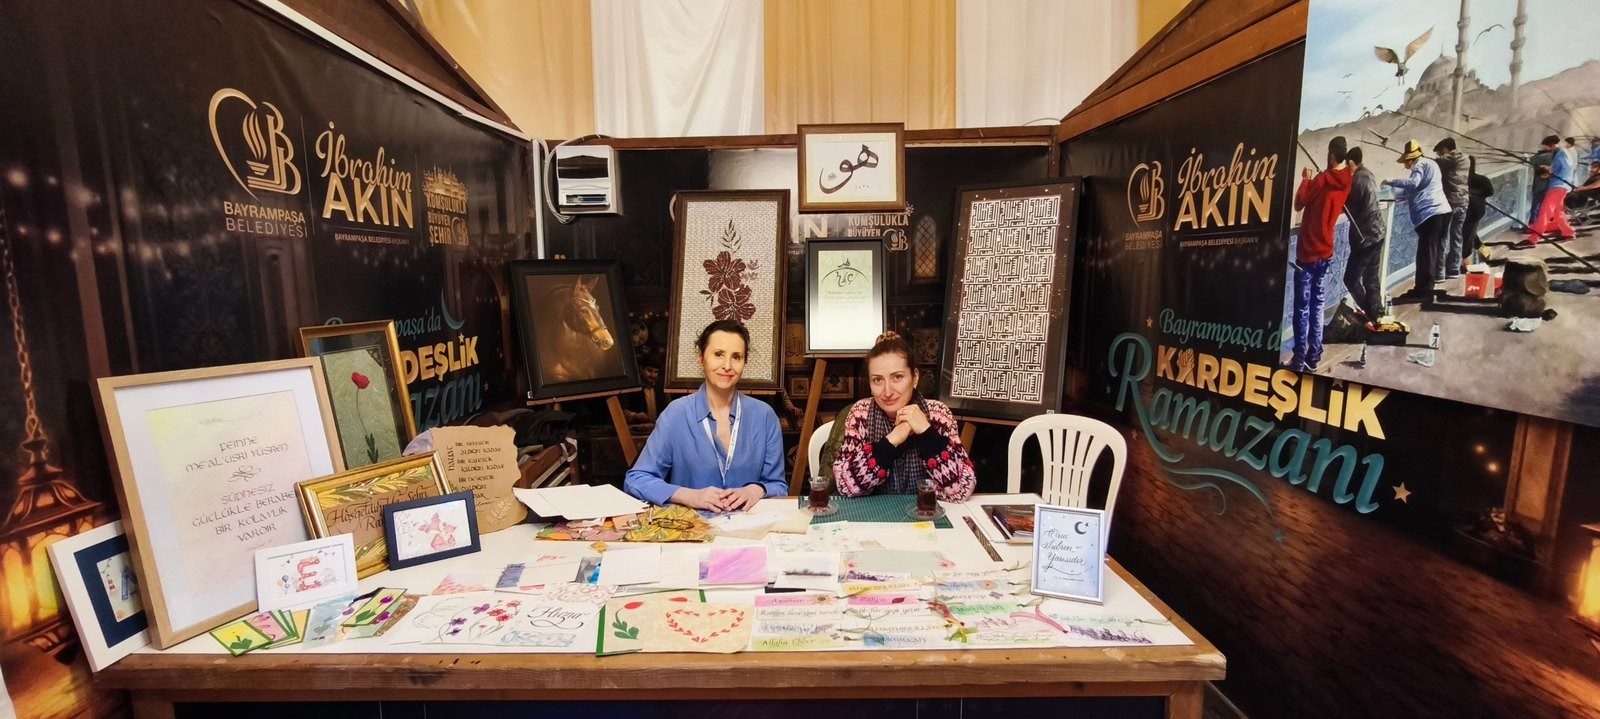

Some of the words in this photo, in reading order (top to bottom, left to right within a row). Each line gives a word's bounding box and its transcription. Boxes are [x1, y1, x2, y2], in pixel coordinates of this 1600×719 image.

[315, 121, 412, 193] İbrahim
[1178, 142, 1278, 199] İbrahim
[223, 201, 306, 226] BAYRAMPAŞA
[322, 172, 414, 229] AKIN
[1174, 176, 1274, 231] AKIN
[225, 217, 308, 239] BELEDİYESİ
[847, 228, 881, 237] BÜYÜYEN
[848, 214, 909, 228] KOMŞULUKLA
[1125, 230, 1163, 241] BAYRAMPAŞA
[1159, 308, 1283, 352] Bayrampaşa'd
[1108, 332, 1386, 514] Ramazanı
[255, 490, 295, 509] BERABE
